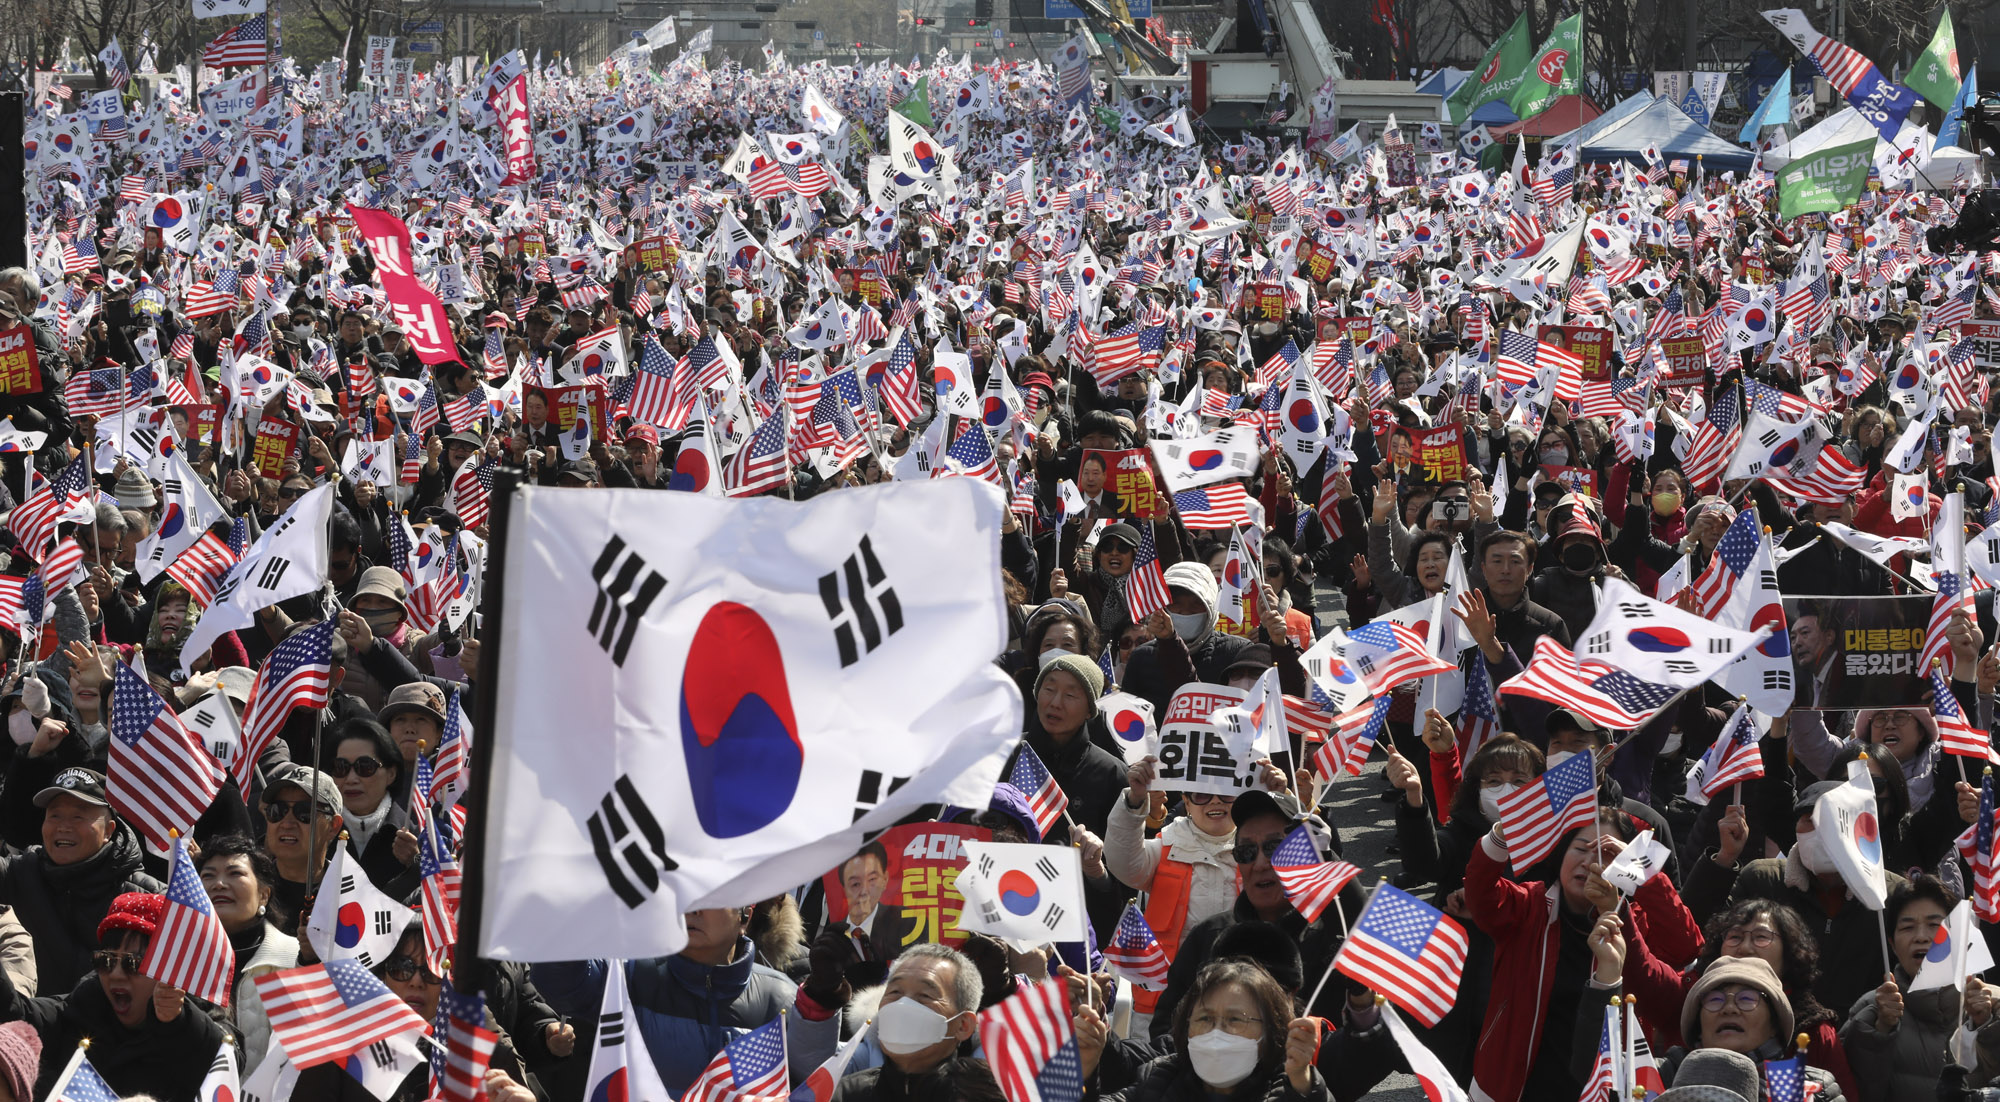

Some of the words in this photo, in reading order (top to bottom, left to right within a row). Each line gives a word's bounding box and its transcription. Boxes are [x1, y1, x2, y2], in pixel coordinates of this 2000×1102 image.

[640, 242, 661, 250] 4대4
[640, 249, 663, 261] 탄핵
[1316, 248, 1335, 260] 4대4
[642, 260, 663, 272] 기각
[1262, 287, 1282, 296] 4대4
[1261, 296, 1283, 308] 탄핵
[1261, 306, 1283, 319] 기각
[0, 333, 26, 353] 대4
[1573, 331, 1602, 343] 4대4
[258, 420, 292, 439] 4대4
[1421, 428, 1457, 447] 4대4
[253, 435, 288, 459] 탄핵
[1421, 444, 1461, 466] 탄핵
[252, 454, 284, 476] 기각
[1423, 463, 1463, 483] 기각
[1116, 470, 1155, 494] 탄핵
[1116, 491, 1157, 514] 기각
